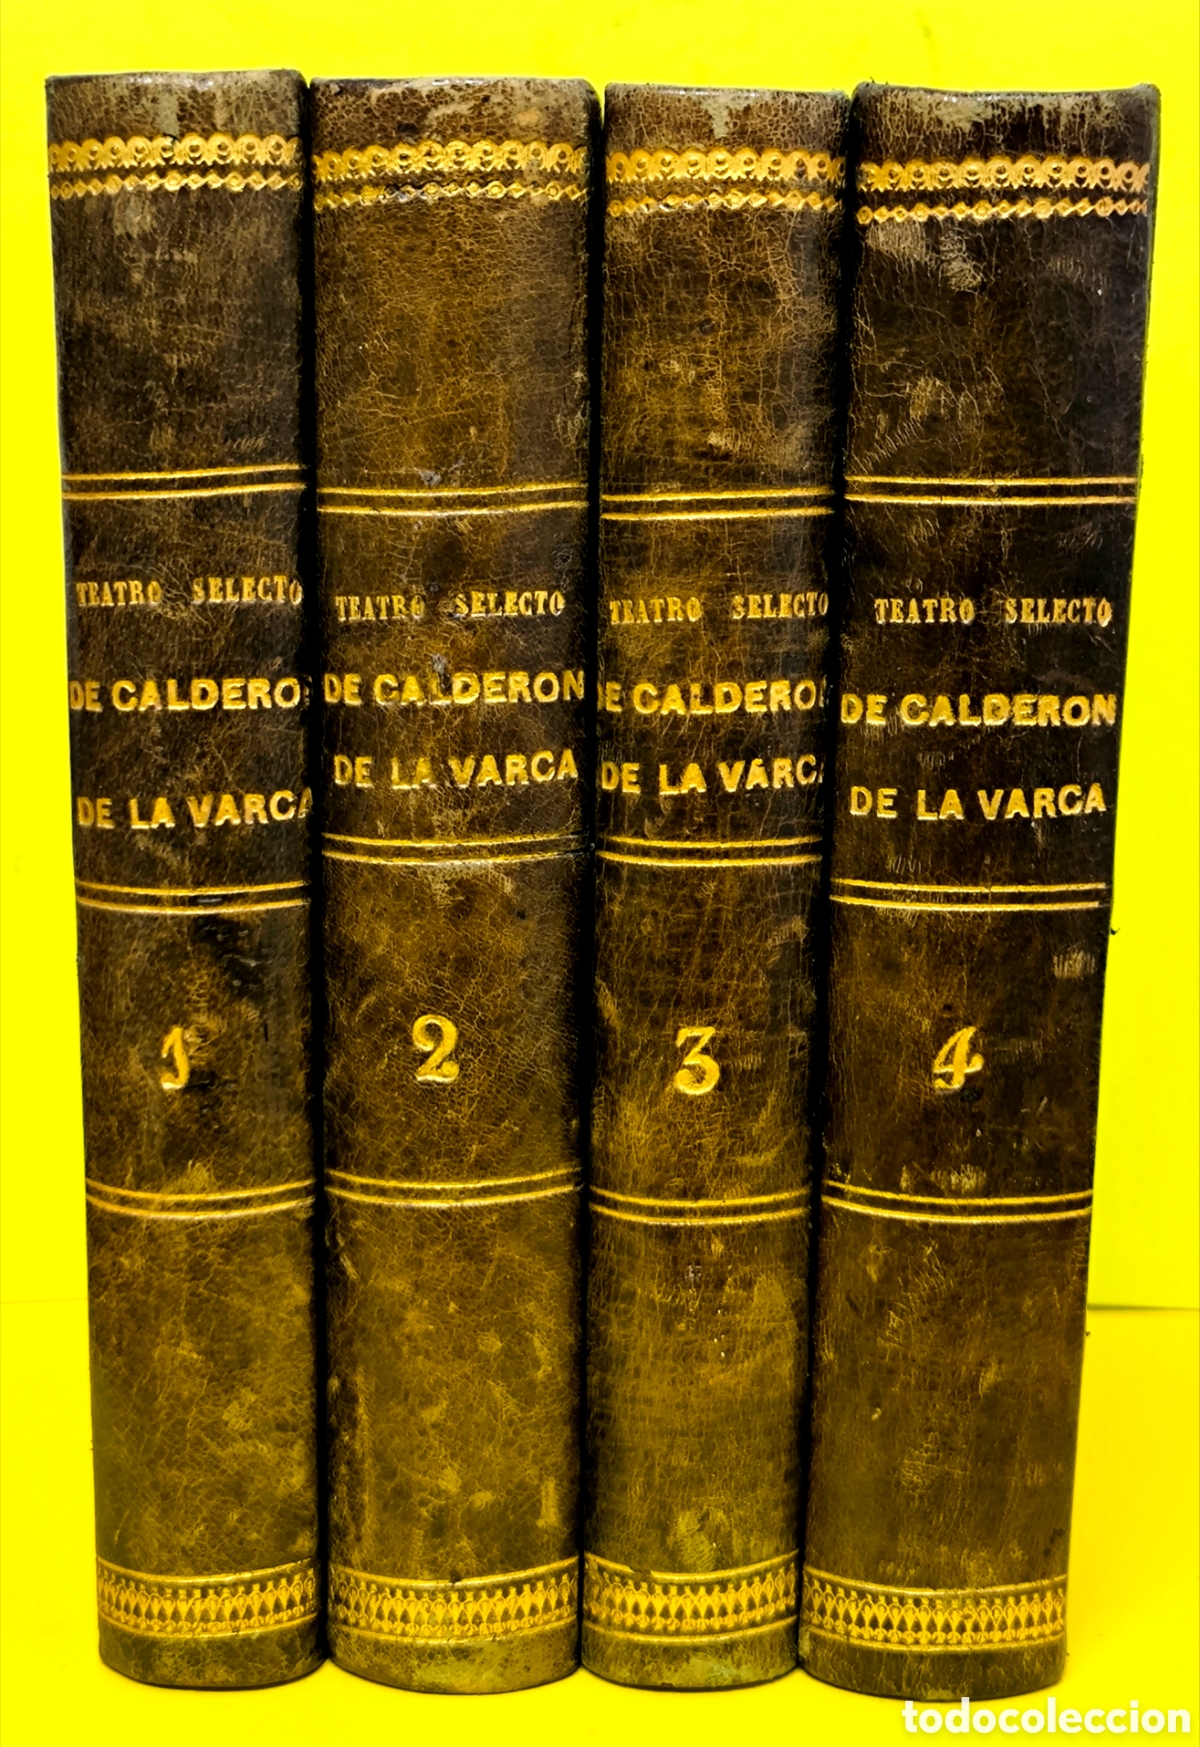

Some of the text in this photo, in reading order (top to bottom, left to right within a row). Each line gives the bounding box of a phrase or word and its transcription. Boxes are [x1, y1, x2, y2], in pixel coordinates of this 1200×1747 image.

[76, 575, 303, 606] TEATRO SELECTO
[335, 590, 566, 621] TEATRO SELECTO
[609, 592, 829, 624] TEATRO SELECTO
[874, 597, 1113, 627] TEATRO SELECTO
[69, 675, 312, 712] DE CALDERO
[324, 670, 585, 705] DE CALDERON
[840, 693, 1117, 727] DE CALDERON
[334, 749, 578, 789] DE LA VARCA
[601, 754, 824, 795] DE LA VARC
[77, 796, 114, 829] DE
[129, 797, 175, 829] LA
[850, 782, 1106, 820] DE LA VARCA
[161, 1026, 190, 1090] 1
[412, 1013, 459, 1084] 2
[675, 1026, 721, 1095] 3
[933, 1026, 984, 1092] 4
